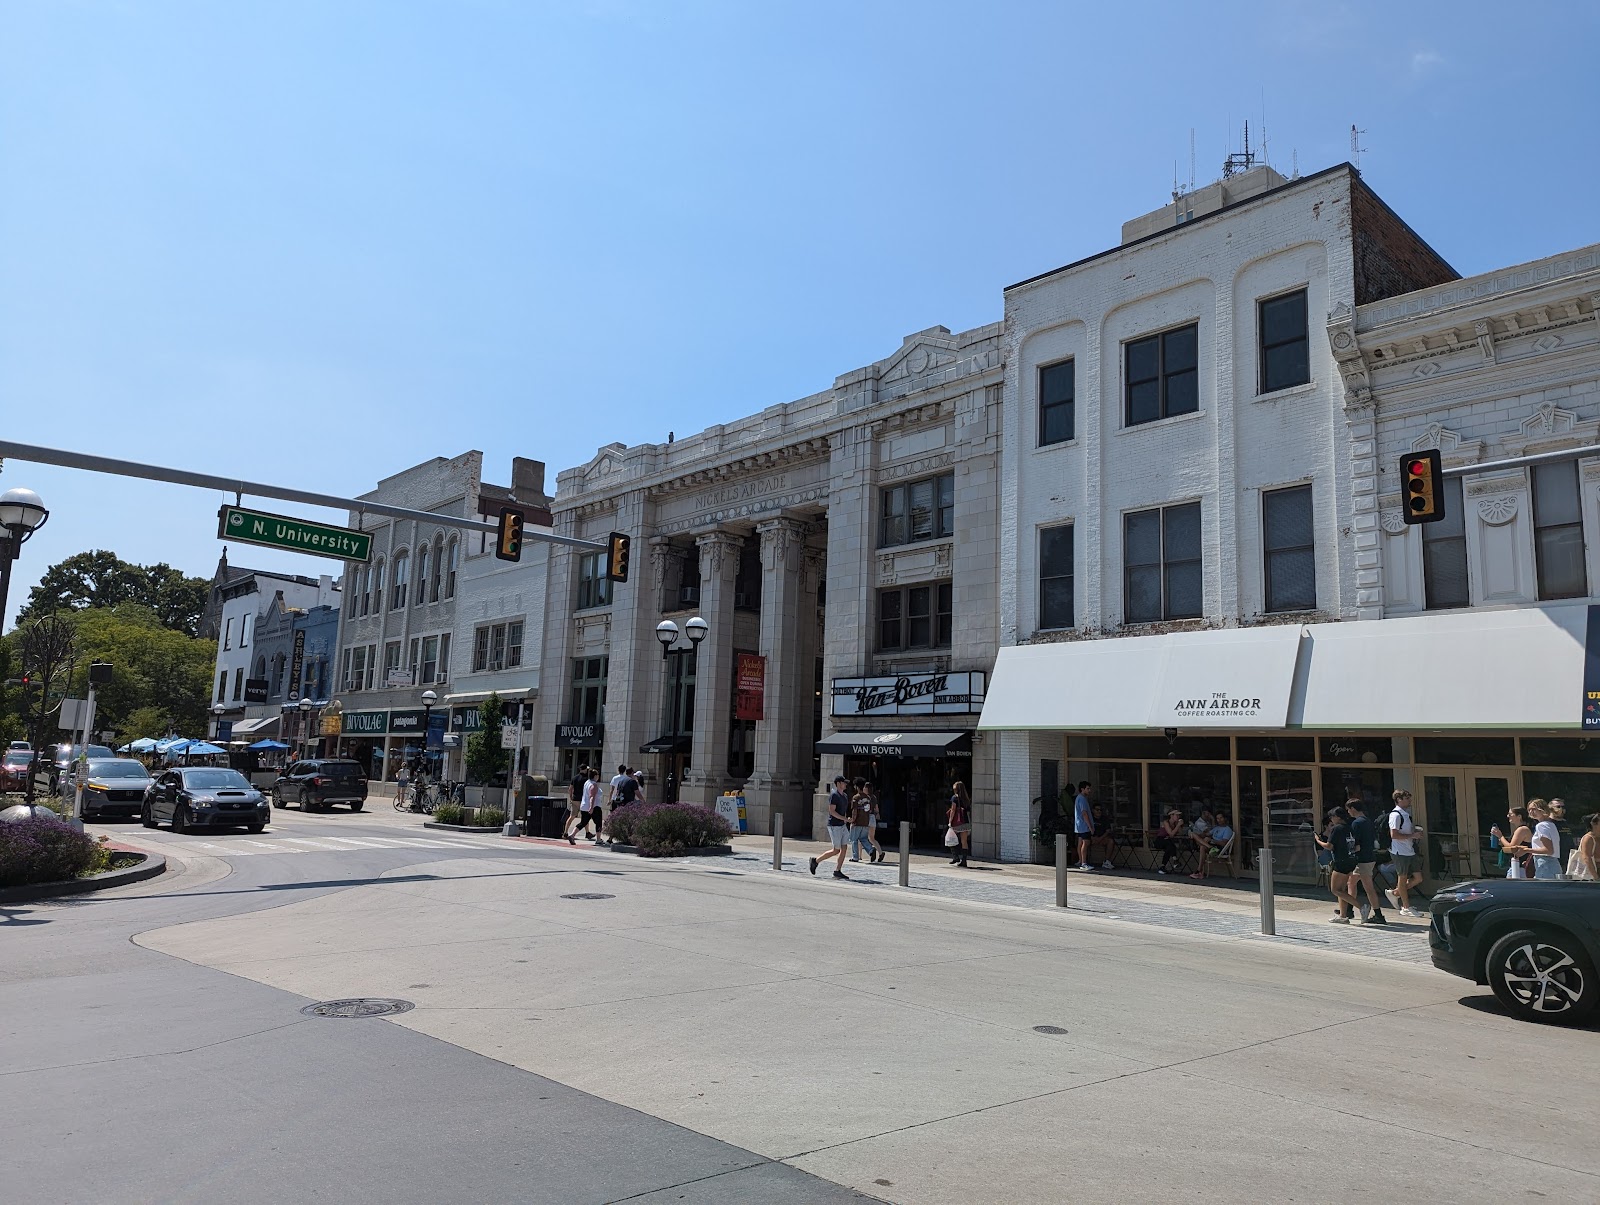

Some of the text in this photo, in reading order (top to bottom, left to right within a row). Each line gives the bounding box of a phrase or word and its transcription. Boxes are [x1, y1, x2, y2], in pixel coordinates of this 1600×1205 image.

[695, 475, 786, 509] NICKELS ARCADE
[252, 519, 359, 554] N. University
[1174, 698, 1261, 711] ANN ARBOR
[346, 714, 382, 730] BIVOUAC
[393, 716, 418, 727] patagonia
[560, 725, 594, 738] BIVOUAC
[852, 745, 902, 755] VAN BOVEN
[1329, 743, 1355, 756] Open
